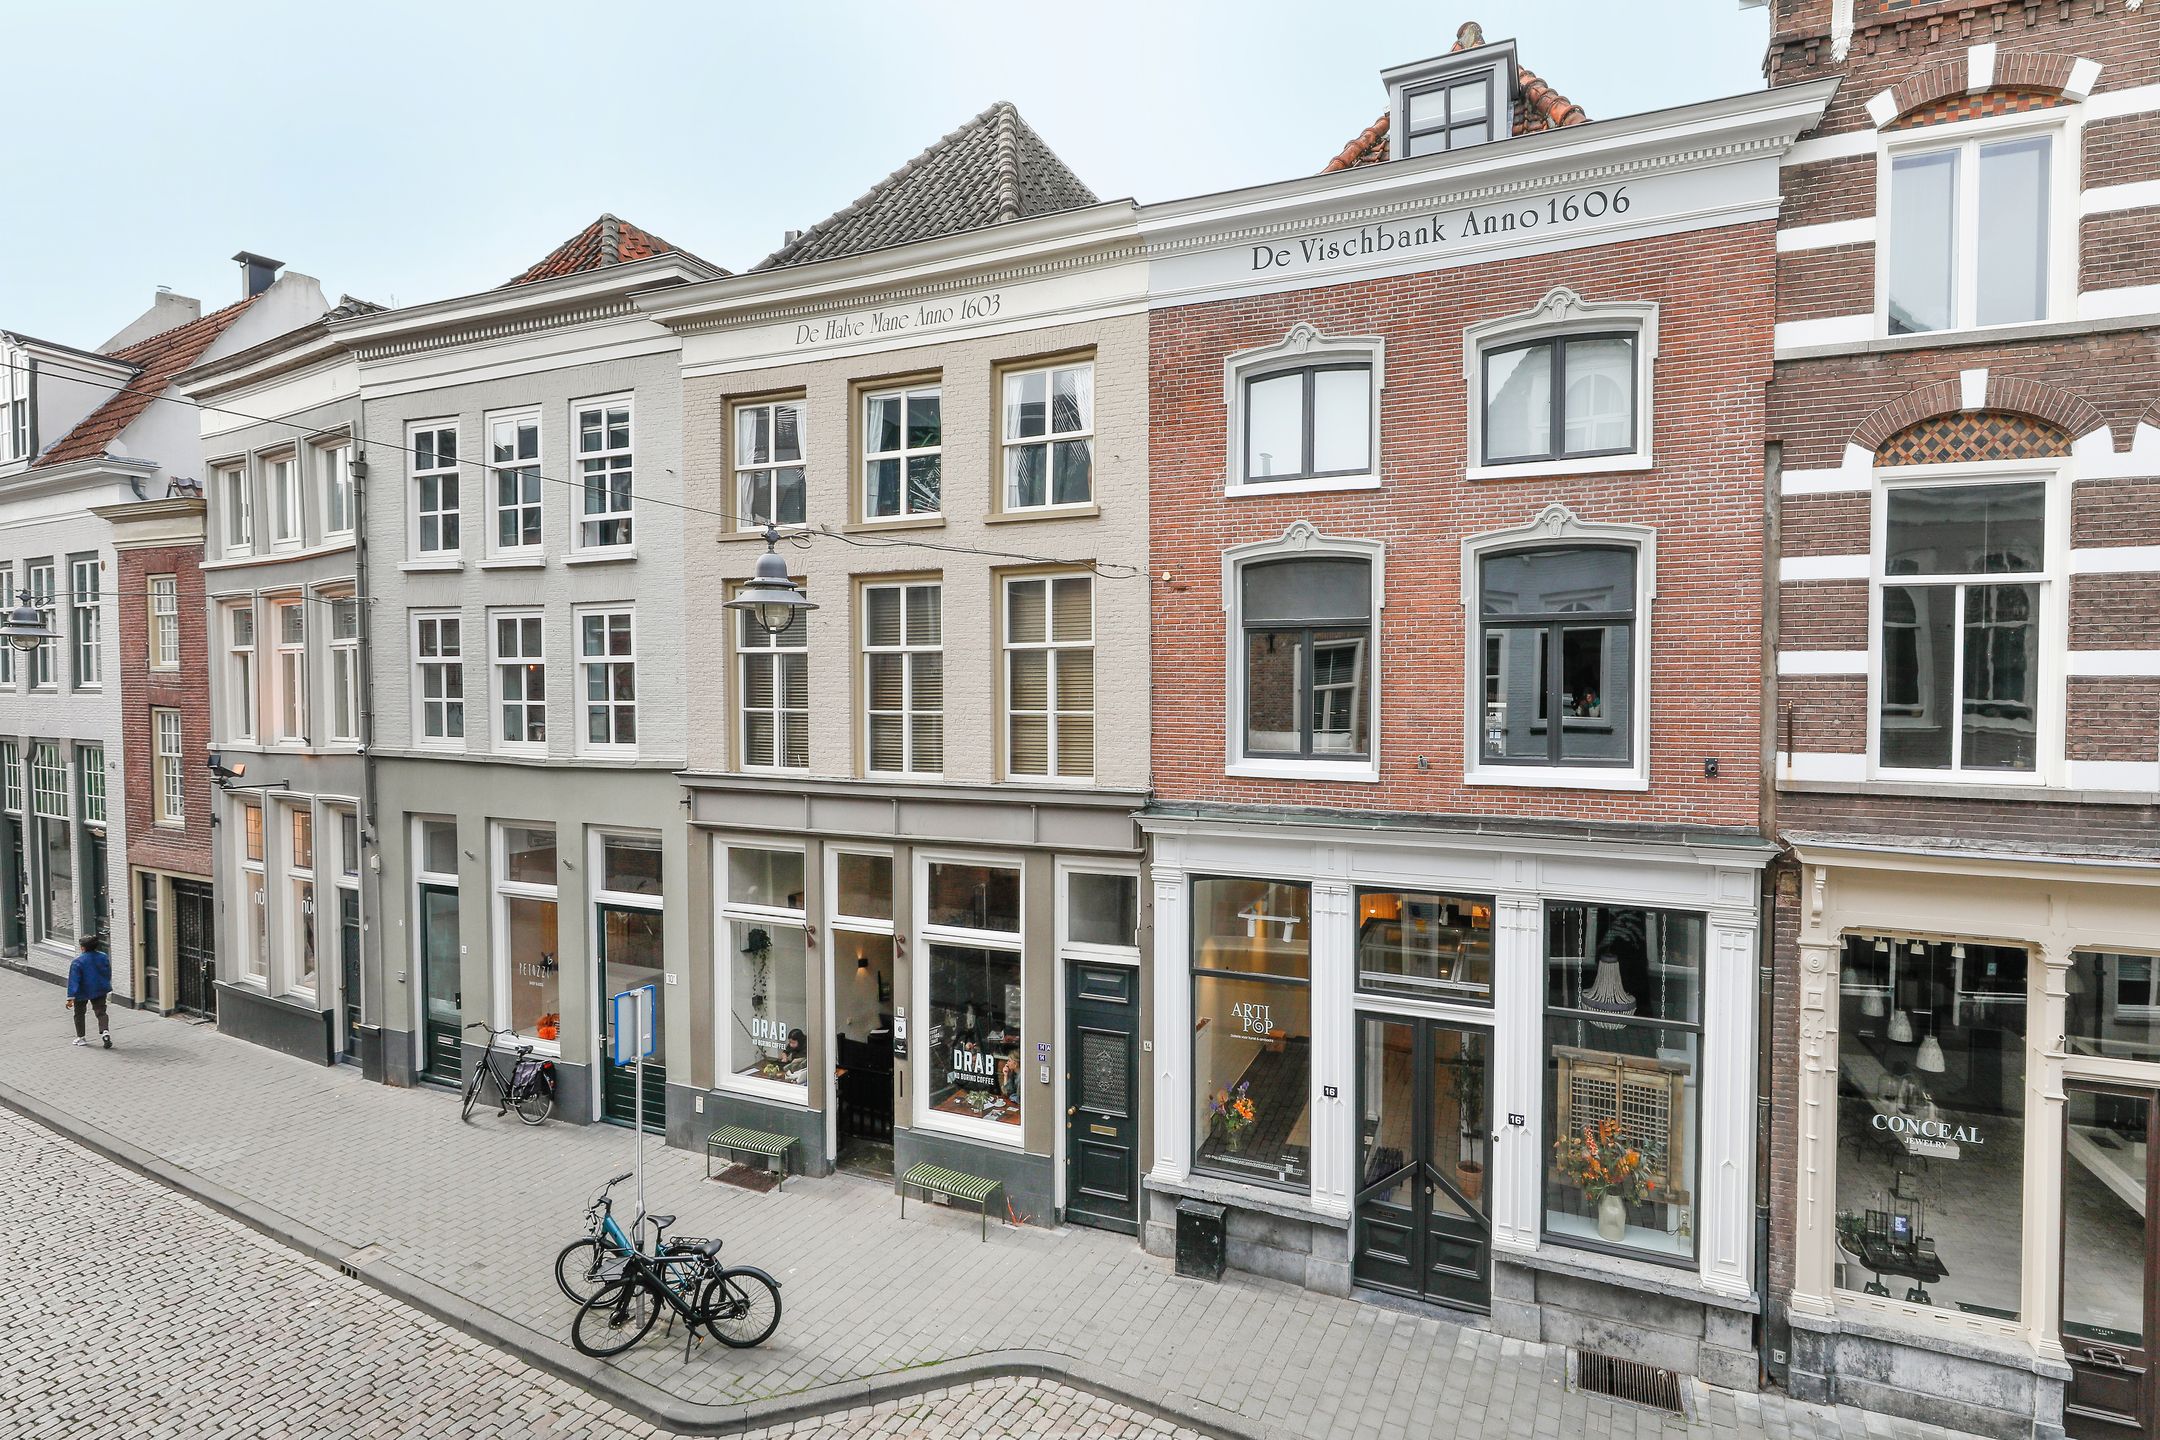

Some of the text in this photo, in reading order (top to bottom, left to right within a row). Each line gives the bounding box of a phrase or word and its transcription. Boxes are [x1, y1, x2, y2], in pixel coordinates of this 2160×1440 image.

[1251, 186, 1631, 271] De Vischbank Anno 1606
[794, 294, 1001, 345] De Halve Mane Anno 1603
[1231, 1002, 1270, 1020] ARTI
[752, 1017, 787, 1042] DRAB
[1243, 1017, 1274, 1035] POP
[954, 1049, 995, 1076] DRAB
[960, 1073, 976, 1082] BORING
[977, 1075, 995, 1086] COFFEE
[1325, 1087, 1336, 1096] 16
[1872, 1114, 1984, 1144] CONCEAL
[1904, 1137, 1948, 1149] JEWELRY
